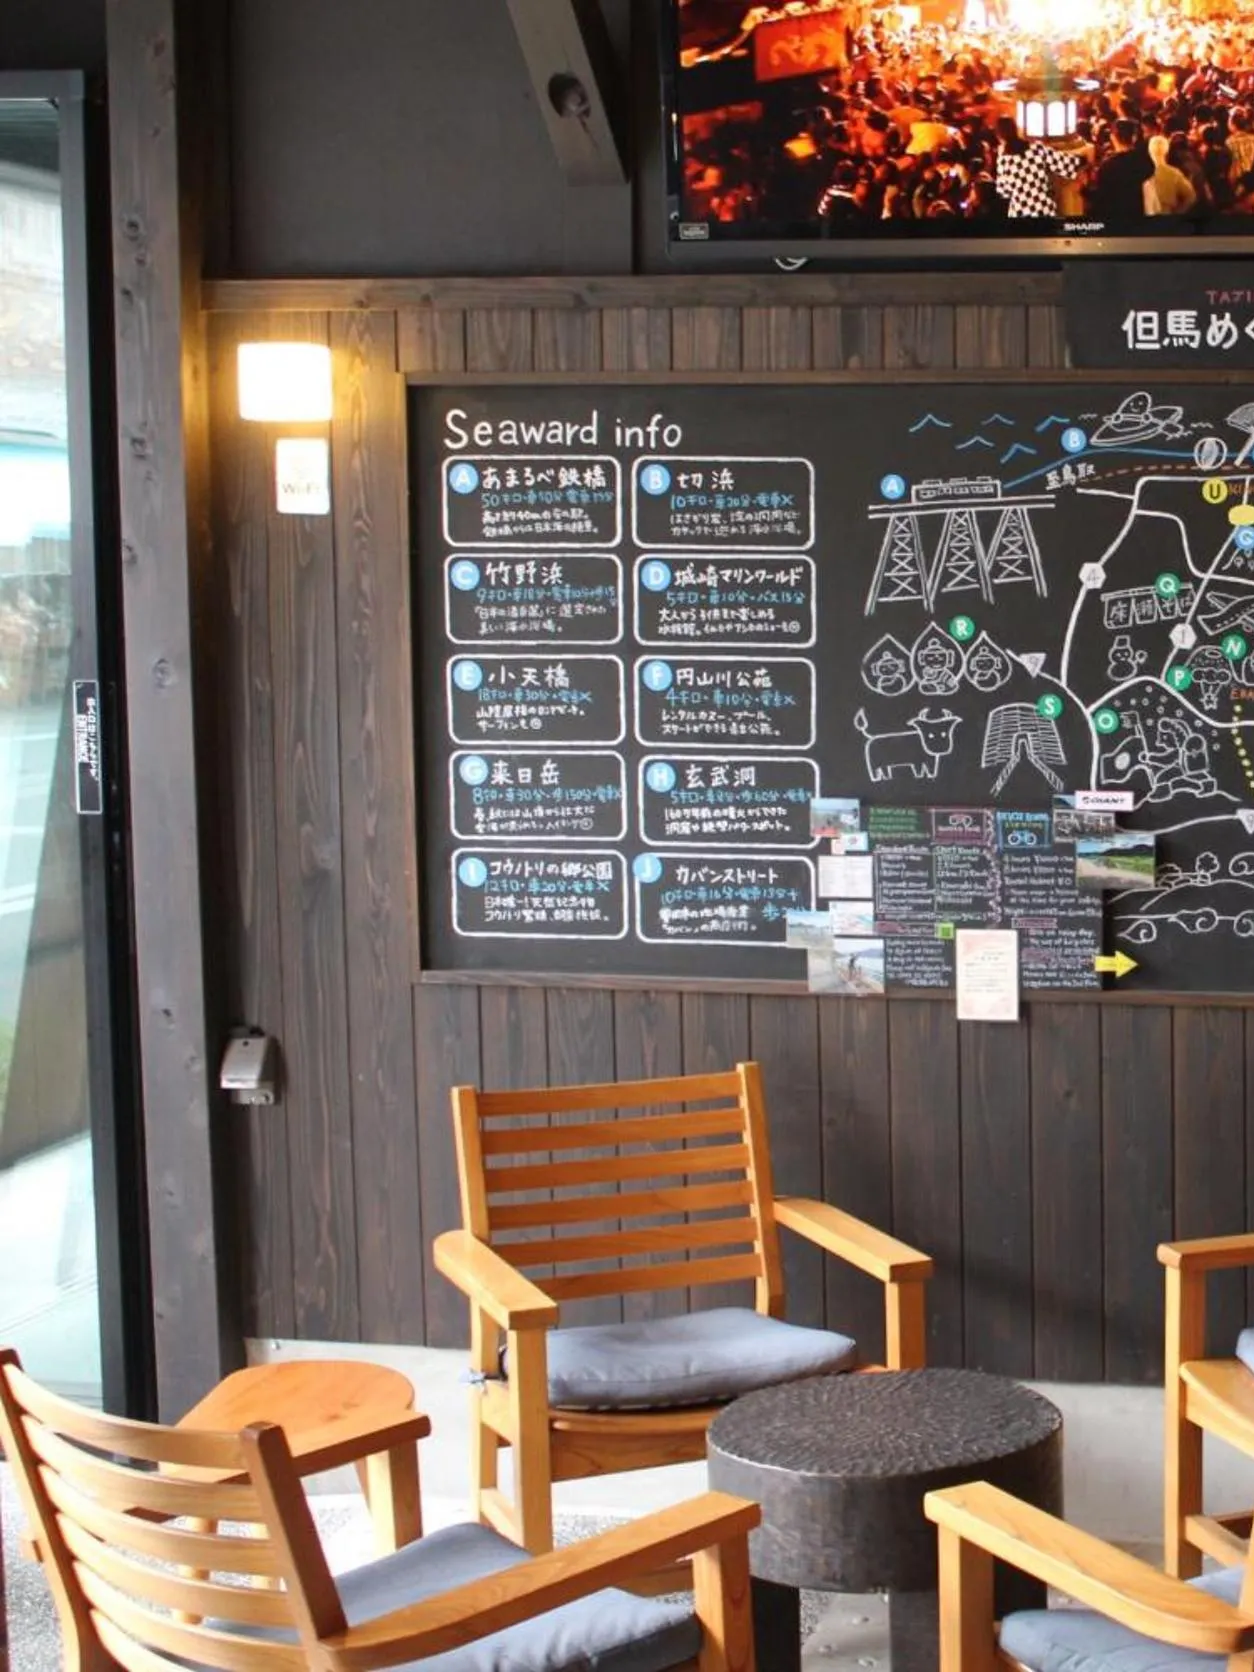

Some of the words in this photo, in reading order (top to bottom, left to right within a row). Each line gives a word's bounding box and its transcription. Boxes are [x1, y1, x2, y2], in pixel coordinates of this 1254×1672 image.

[1063, 222, 1105, 231] SHARP
[444, 408, 600, 451] Seaward
[614, 412, 683, 449] info
[482, 465, 607, 489] あまるべ鉄橋
[485, 560, 564, 587] 竹野浜
[673, 562, 805, 588] 城崎マリンワールド
[487, 662, 570, 689] 小天橋
[490, 758, 561, 786] 来日岳
[684, 762, 757, 790] 玄武洞
[489, 858, 614, 881] コウノトリの郷公園
[675, 863, 781, 886] カバンストリート
